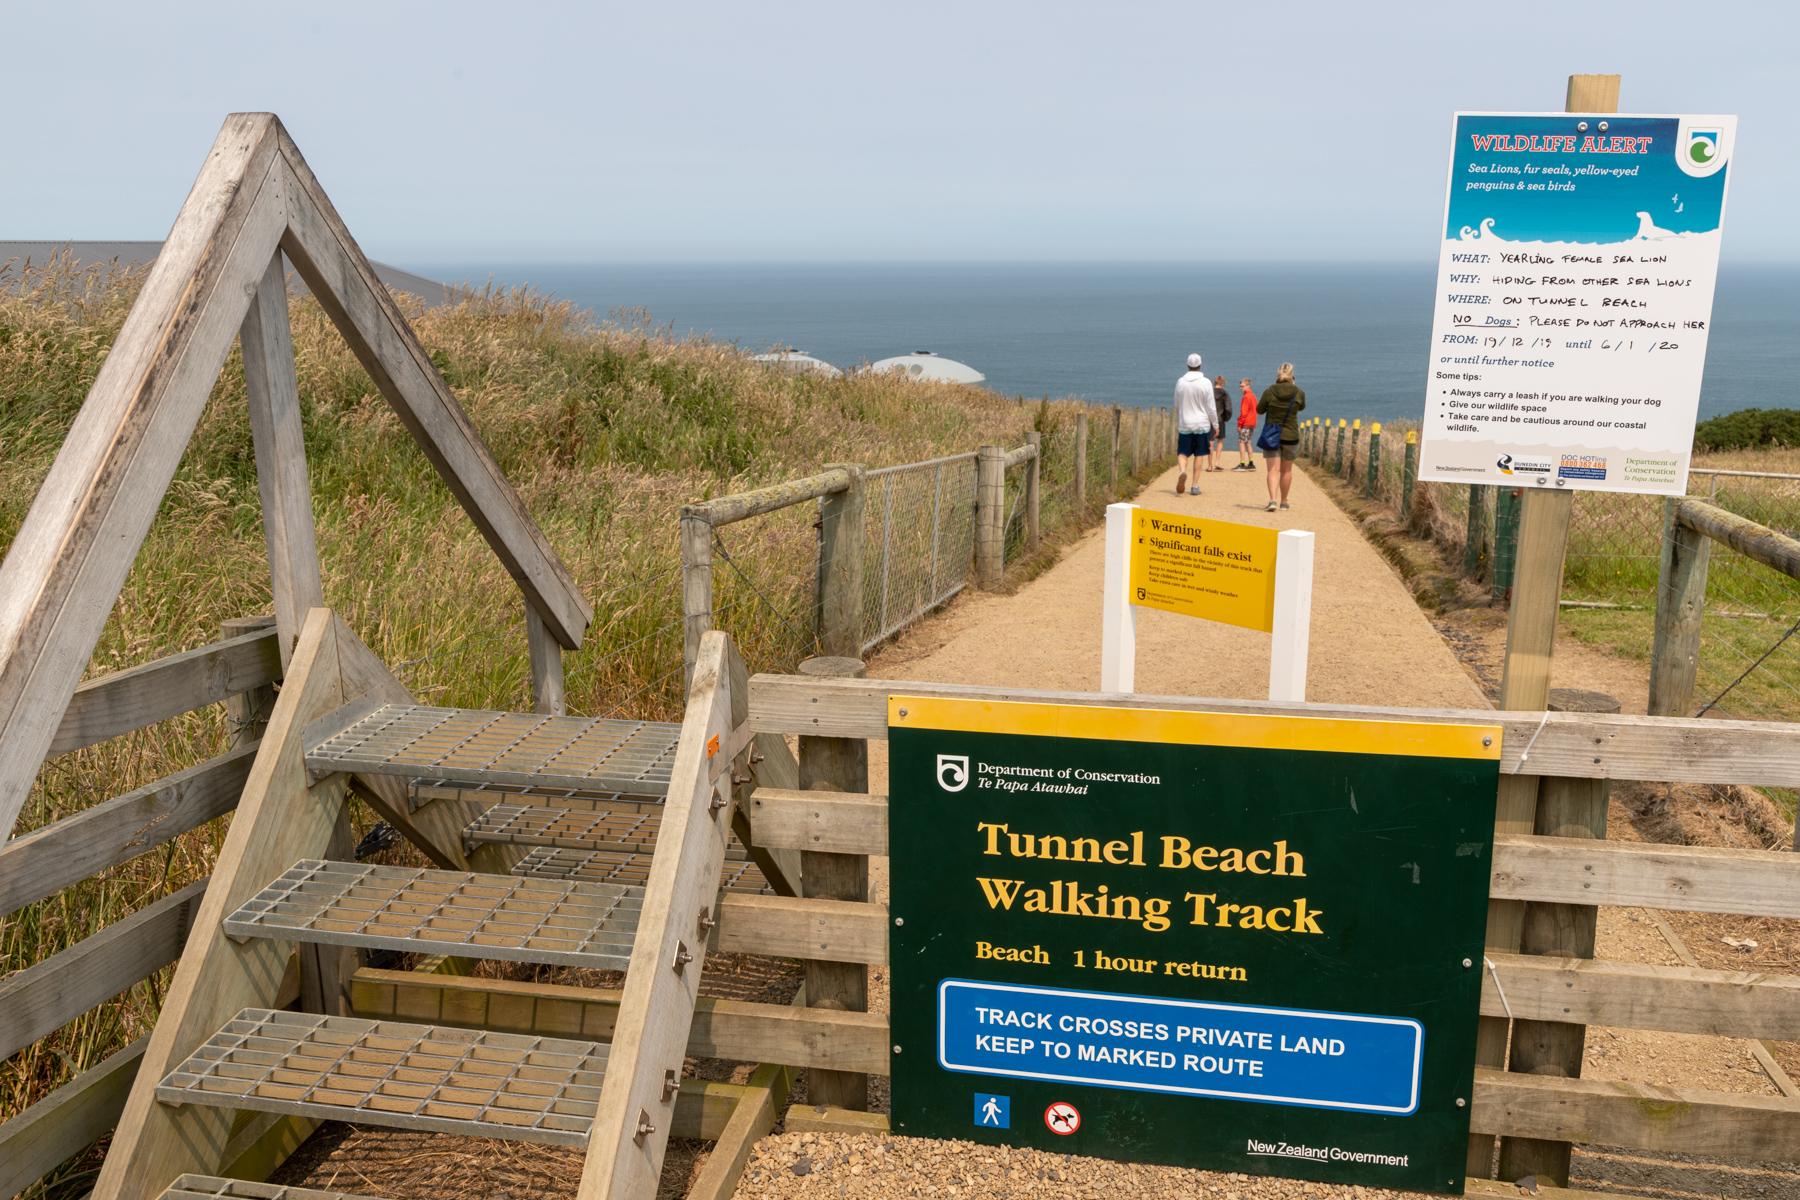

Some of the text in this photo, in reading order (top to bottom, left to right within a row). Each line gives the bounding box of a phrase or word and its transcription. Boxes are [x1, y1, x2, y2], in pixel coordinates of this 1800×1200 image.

[1471, 135, 1652, 154] WILDLIFE ALERT
[1468, 163, 1639, 178] Sea Lions, fur seals, yellow-eyed
[1466, 181, 1515, 192] penguins
[1516, 181, 1525, 191] &
[1547, 180, 1576, 192] birds
[1452, 253, 1491, 264] WHAT:
[1562, 255, 1602, 263] FEMALE
[1612, 255, 1634, 264] SEA
[1450, 274, 1692, 287] WHY: HIDING FROM OTHER SEA LIONS
[1448, 294, 1491, 304] WHERE:
[1528, 297, 1588, 306] TUNNEL
[1602, 298, 1647, 308] BEACH
[1453, 314, 1472, 323] NO
[1529, 315, 1571, 326] PLEASE
[1620, 318, 1676, 329] APPROACH
[1683, 320, 1705, 330] HER
[1442, 334, 1479, 344] FROM:
[1565, 339, 1592, 349] until
[1454, 355, 1480, 365] until
[1481, 355, 1519, 366] further
[1521, 359, 1555, 368] notice
[1436, 371, 1482, 382] Some tips:
[1449, 400, 1469, 409] Give
[1488, 402, 1519, 411] wildlife
[1520, 404, 1547, 413] space
[1450, 389, 1481, 399] Always
[1483, 391, 1506, 400] carry
[1584, 395, 1619, 406] walking
[1643, 398, 1662, 408] dog
[1446, 424, 1480, 432] wildlife.
[1448, 412, 1469, 421] Take
[1523, 416, 1561, 425] cautious
[1563, 419, 1595, 427] around
[1614, 421, 1647, 430] coastal
[1626, 457, 1668, 466] Department
[1624, 466, 1676, 475] Conservation
[1151, 519, 1202, 540] Warning
[1150, 537, 1252, 562] Significant falls exist
[978, 762, 1161, 785] Department of Conservation
[978, 777, 1088, 795] Te Papa Atawhai
[977, 822, 1306, 876] Tunnel Beach
[976, 877, 1324, 934] Walking Track
[975, 942, 1247, 982] Beach 1 hour return
[975, 1007, 1345, 1056] TRACK CROSSES PRIVATE LAND
[975, 1034, 1264, 1078] KEEP TO MARKED ROUTE
[1247, 1139, 1409, 1167] New Zealand Government
